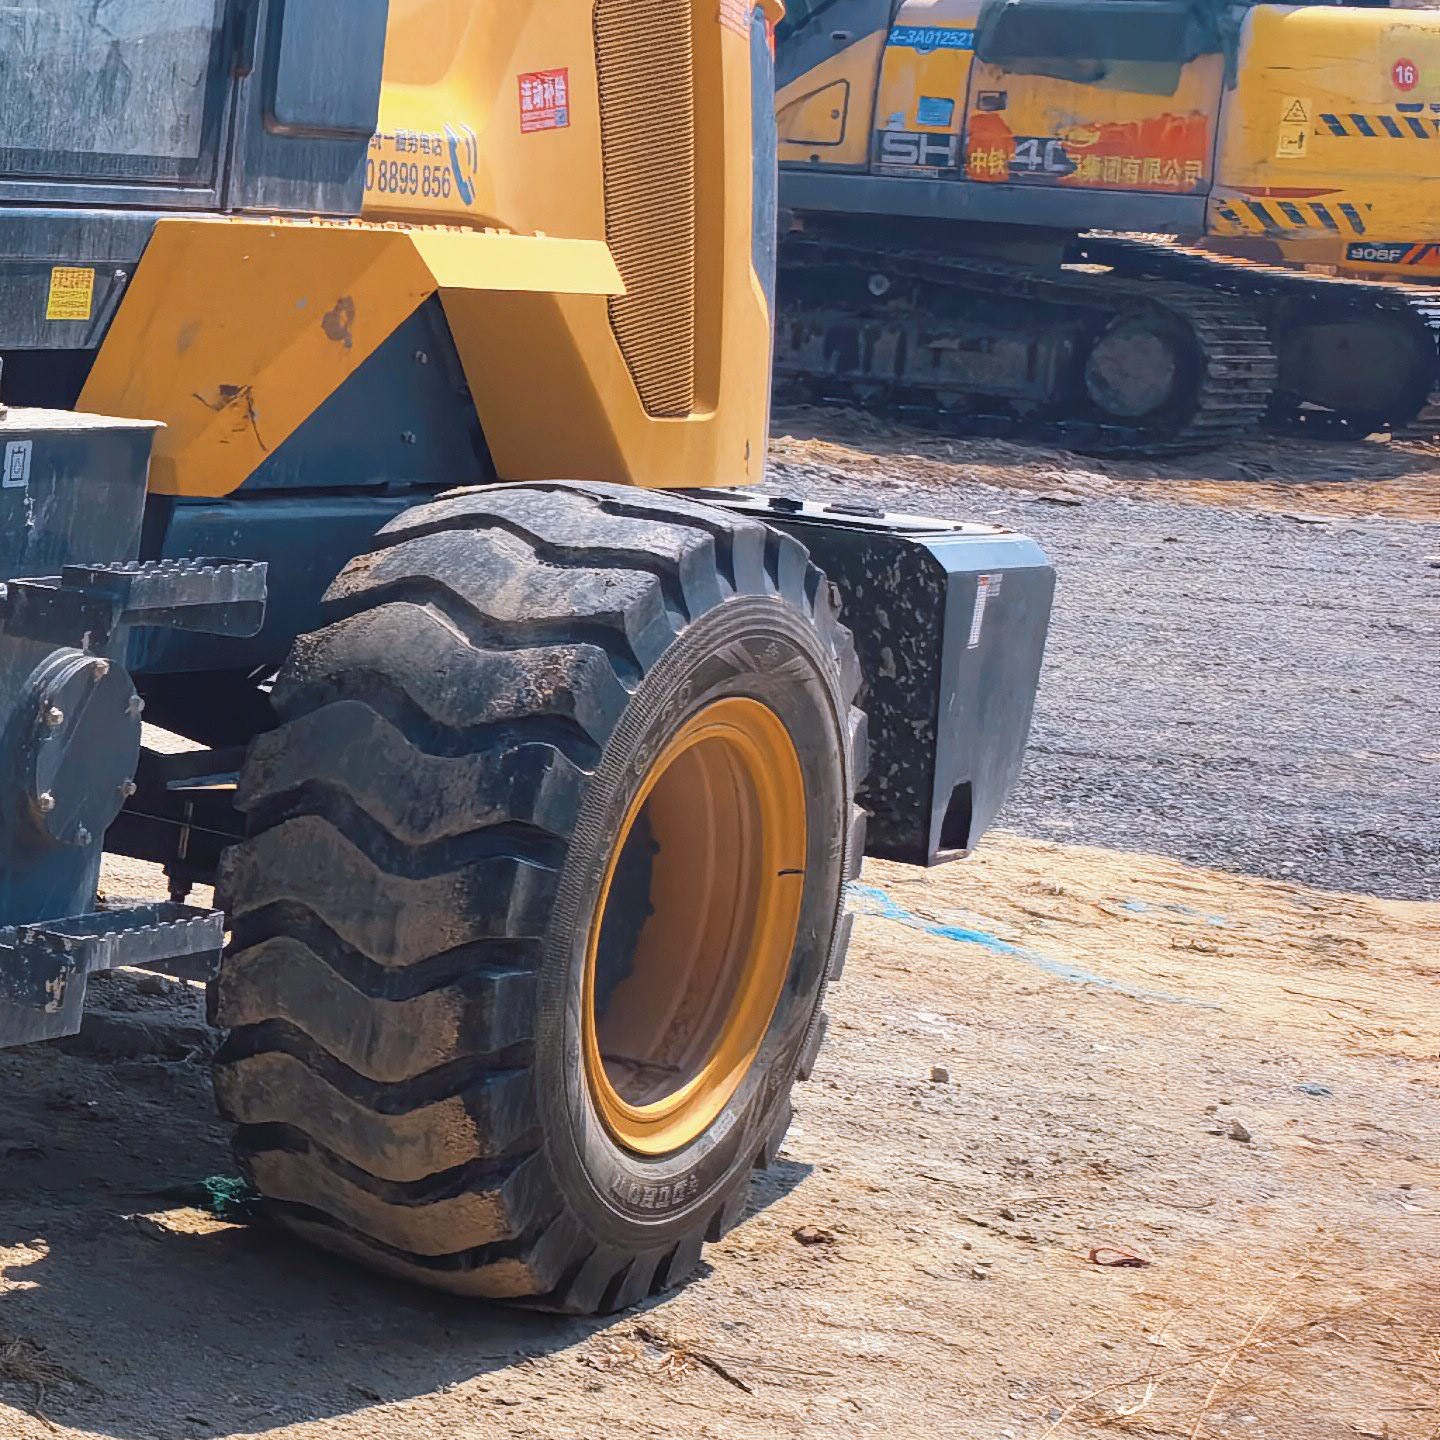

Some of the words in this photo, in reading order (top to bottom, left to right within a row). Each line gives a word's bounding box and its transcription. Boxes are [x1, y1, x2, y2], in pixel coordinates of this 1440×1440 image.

[1396, 65, 1414, 84] 16
[378, 160, 418, 195] 8899
[422, 165, 451, 198] 856
